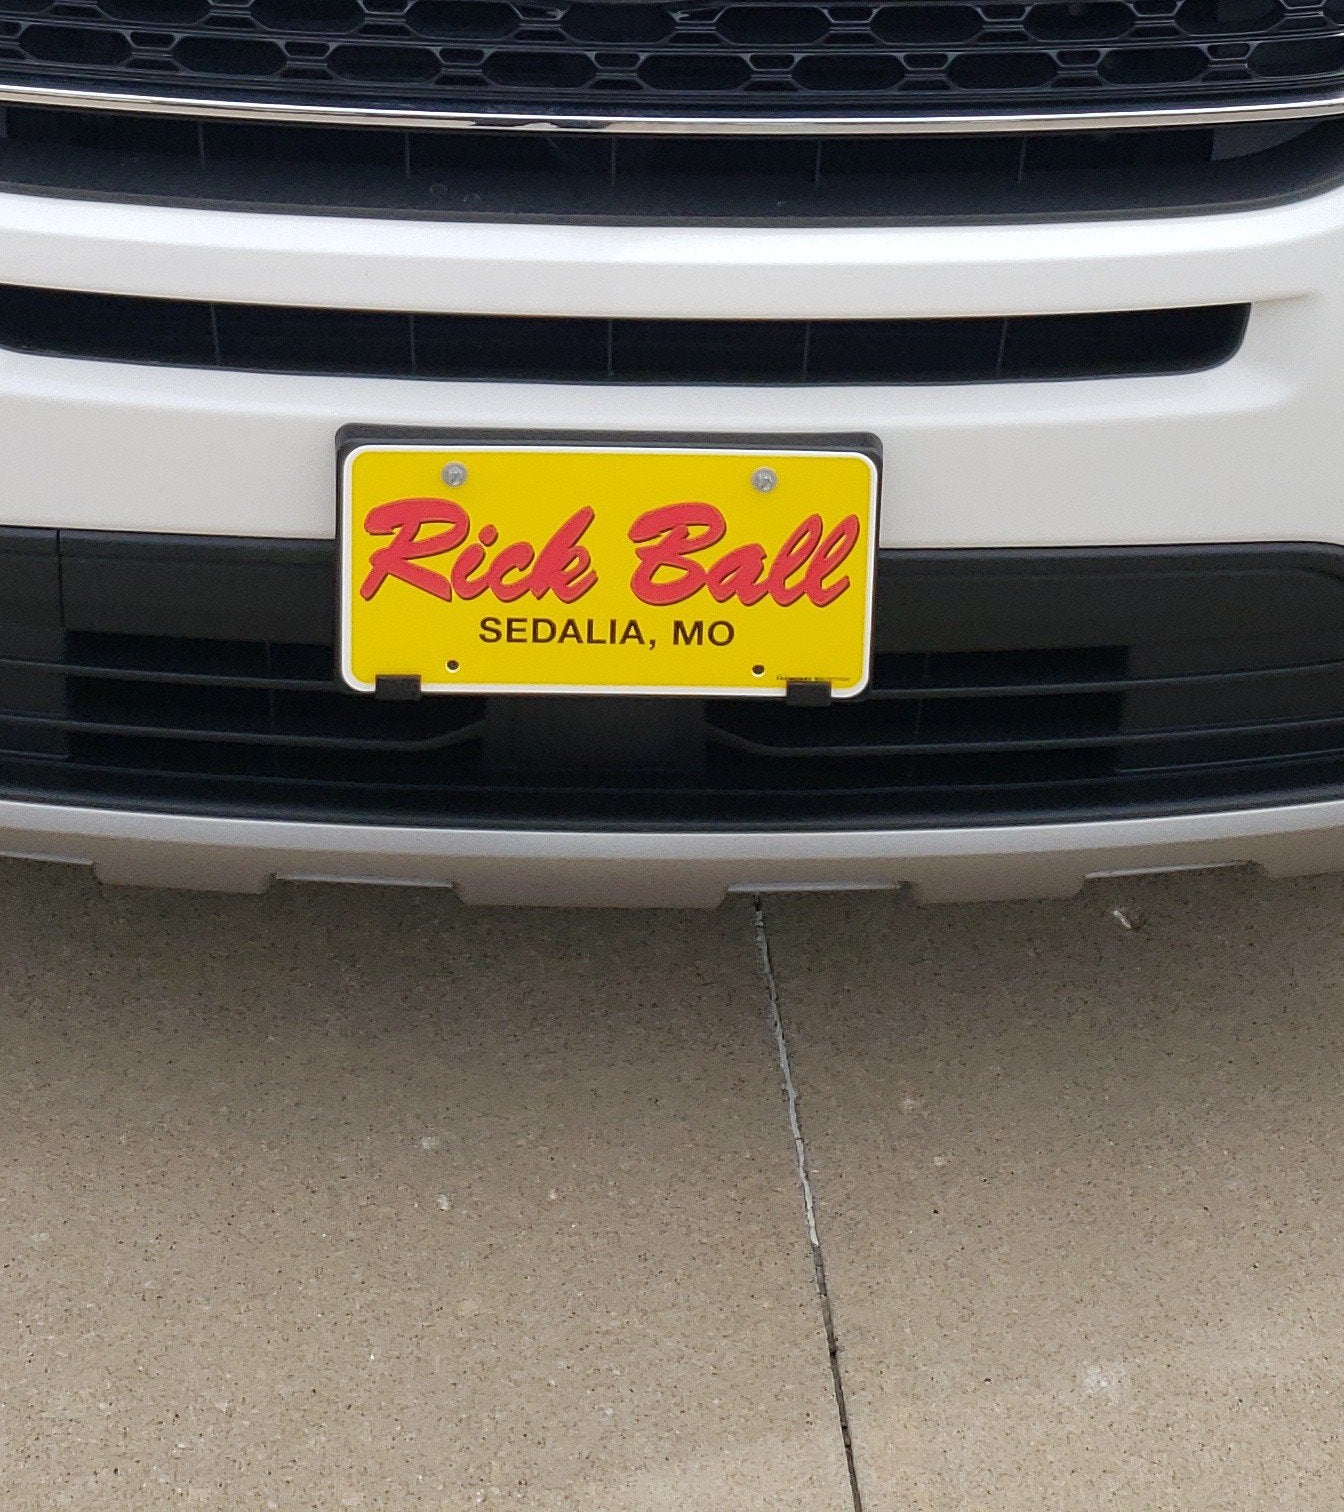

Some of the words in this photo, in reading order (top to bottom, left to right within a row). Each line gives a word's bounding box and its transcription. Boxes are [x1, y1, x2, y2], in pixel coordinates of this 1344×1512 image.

[359, 497, 599, 603] Rick
[628, 501, 860, 608] Ball
[478, 616, 657, 650] SEDALIA,
[672, 619, 736, 647] MO
